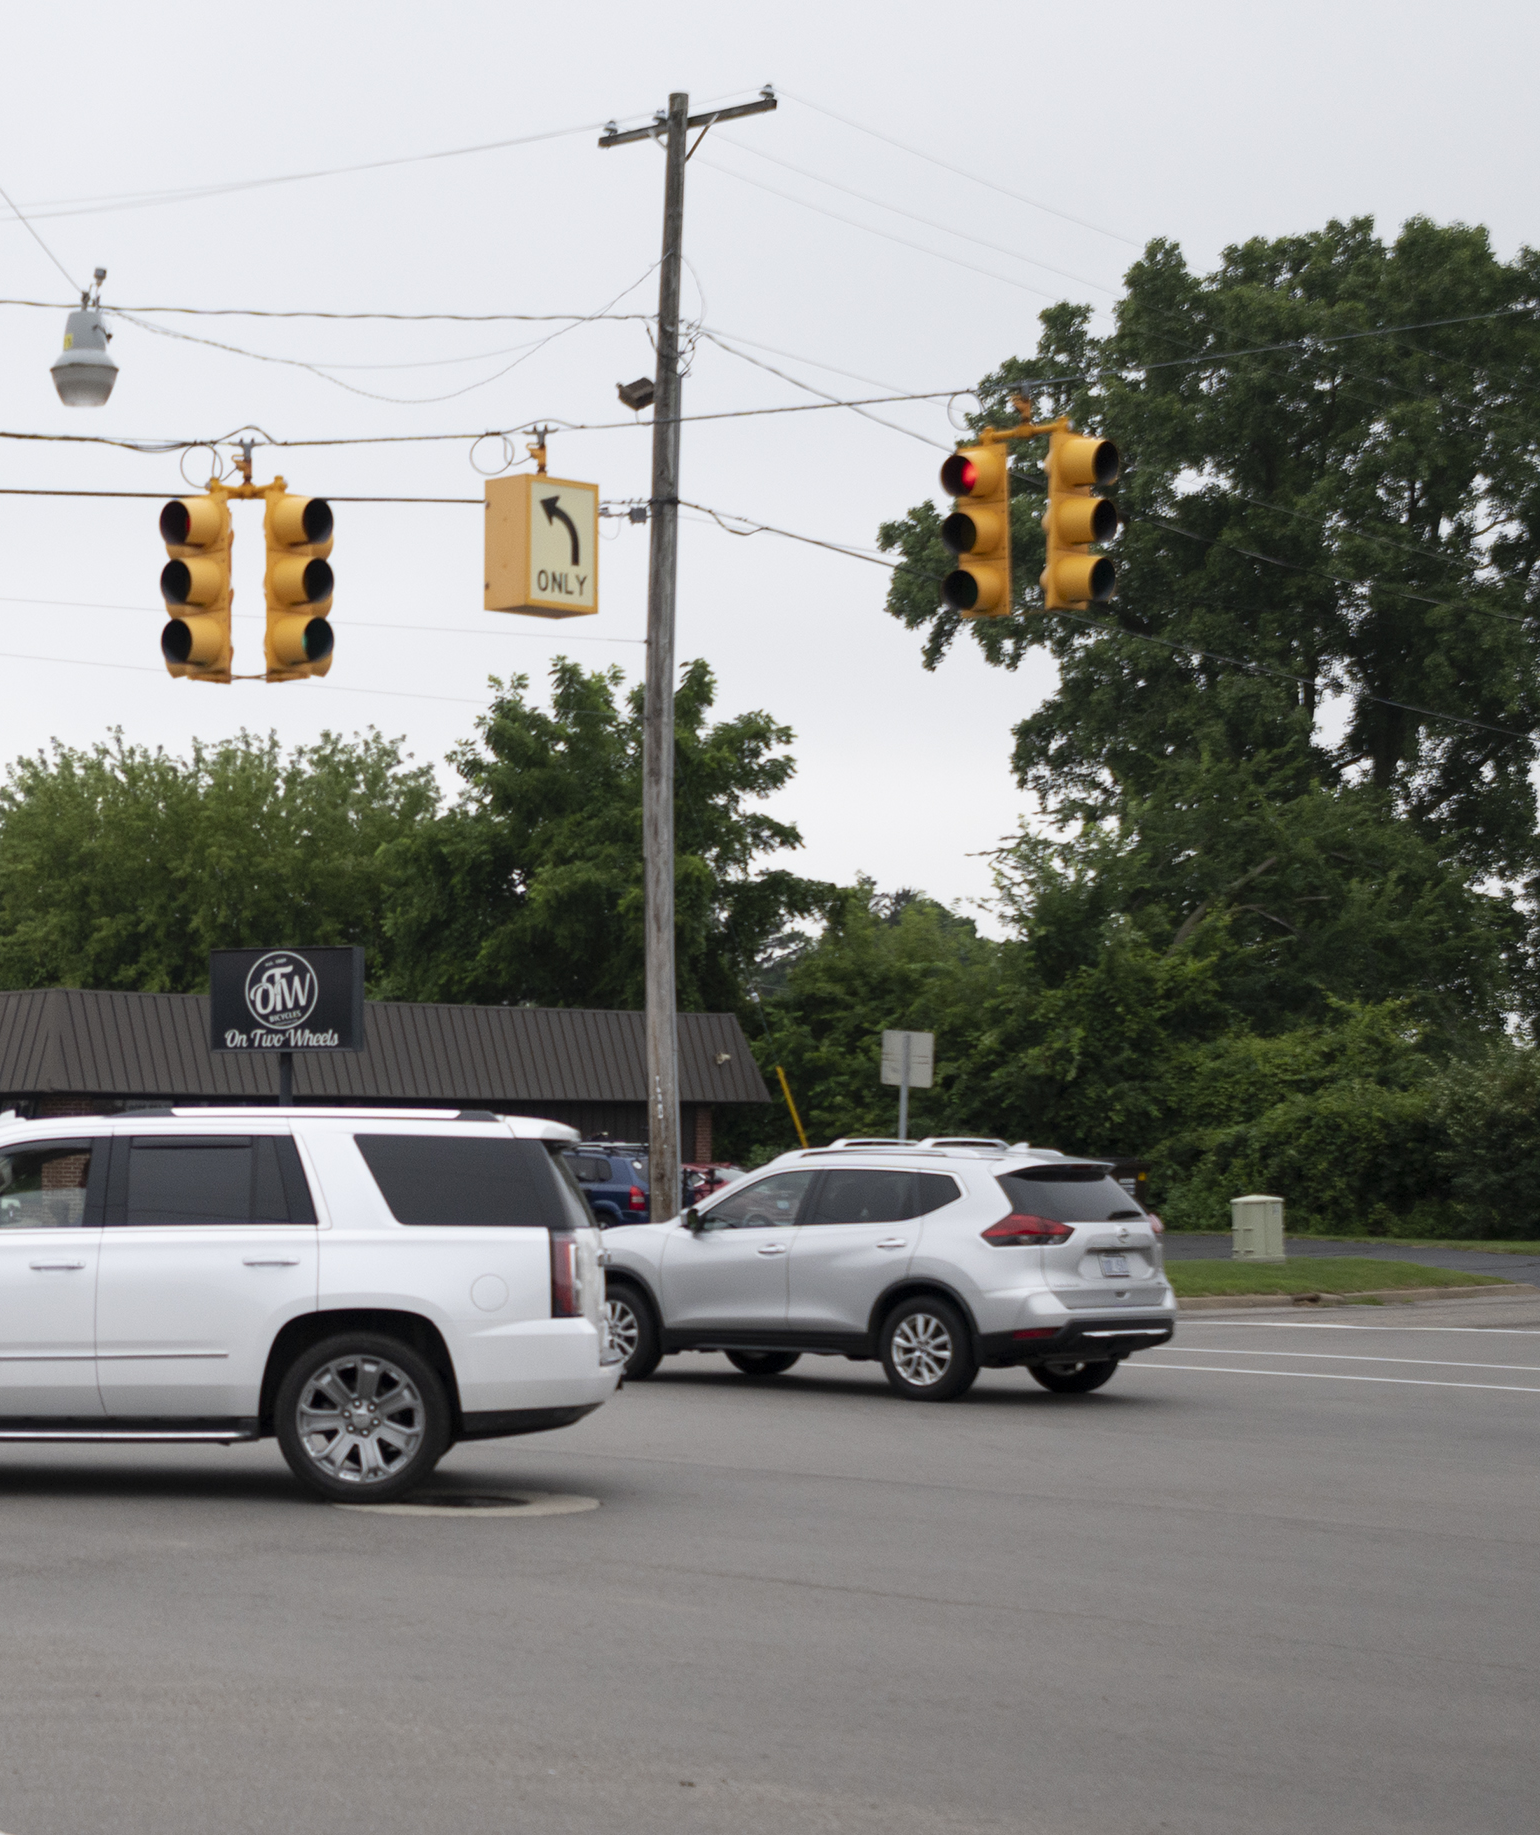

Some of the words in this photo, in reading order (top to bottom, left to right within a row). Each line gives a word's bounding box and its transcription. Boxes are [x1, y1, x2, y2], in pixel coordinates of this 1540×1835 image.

[537, 569, 588, 597] ONLY
[224, 1029, 248, 1048] On
[250, 1029, 285, 1048] Two
[286, 1028, 339, 1047] Wheels
